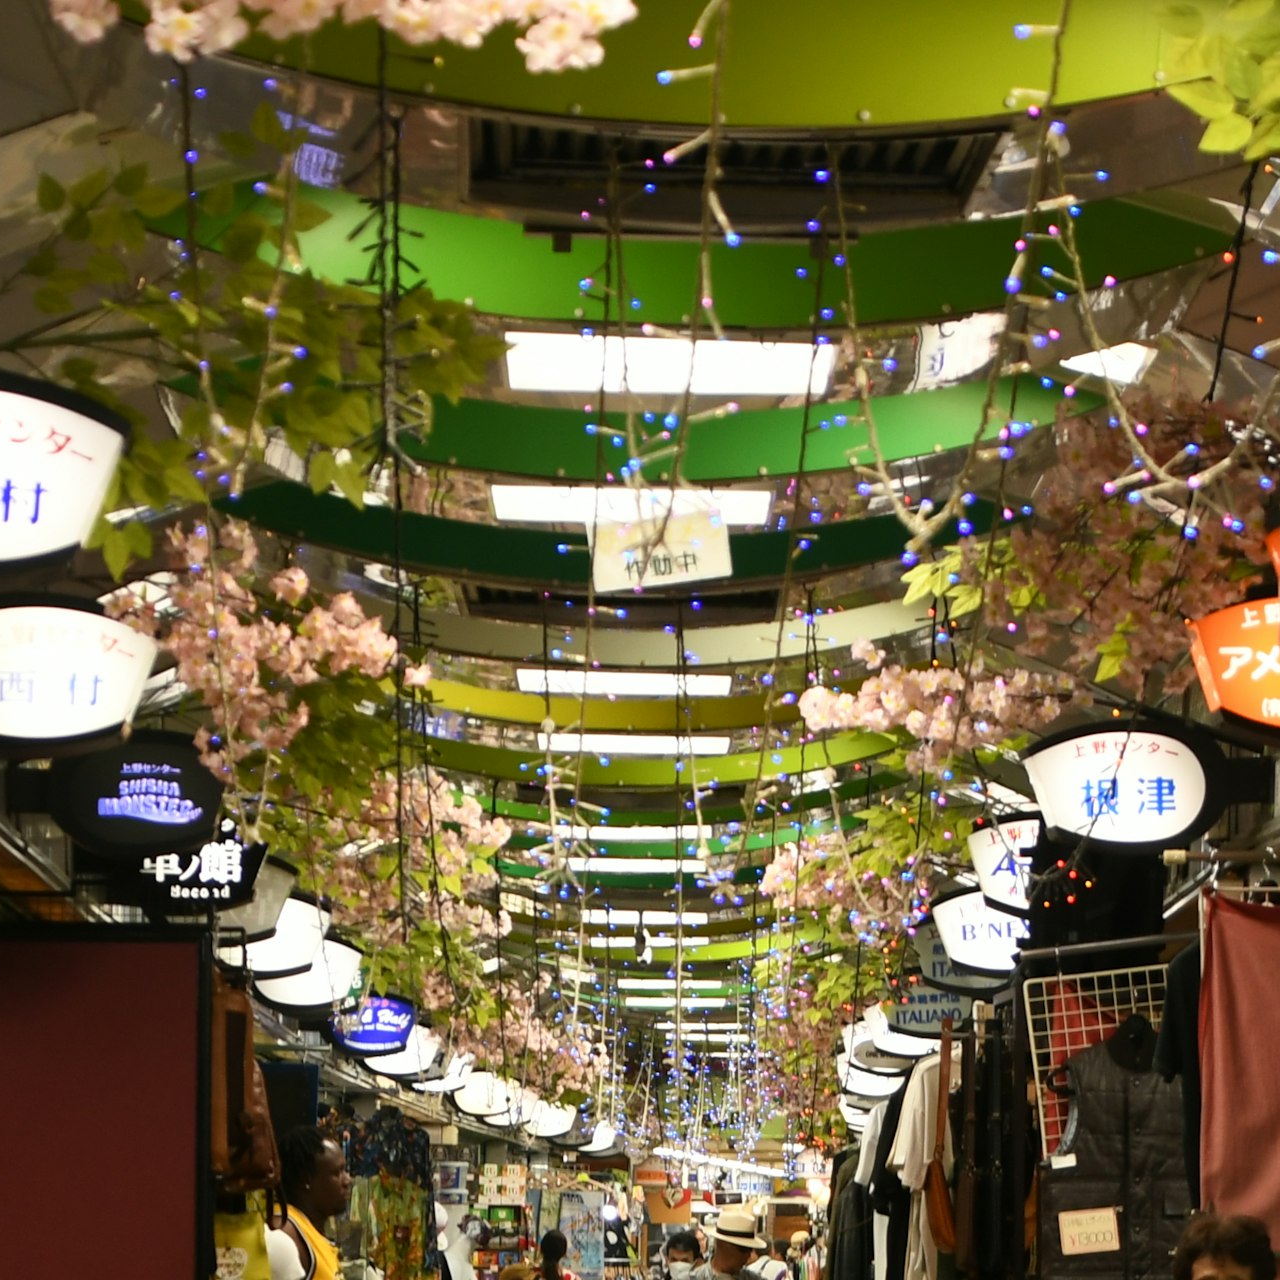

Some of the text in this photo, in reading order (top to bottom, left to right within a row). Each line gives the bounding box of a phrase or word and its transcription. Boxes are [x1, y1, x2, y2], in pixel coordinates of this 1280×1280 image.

[119, 778, 180, 796] SHISHA
[1081, 777, 1177, 817] 根津
[896, 1007, 962, 1025] ITALIANO
